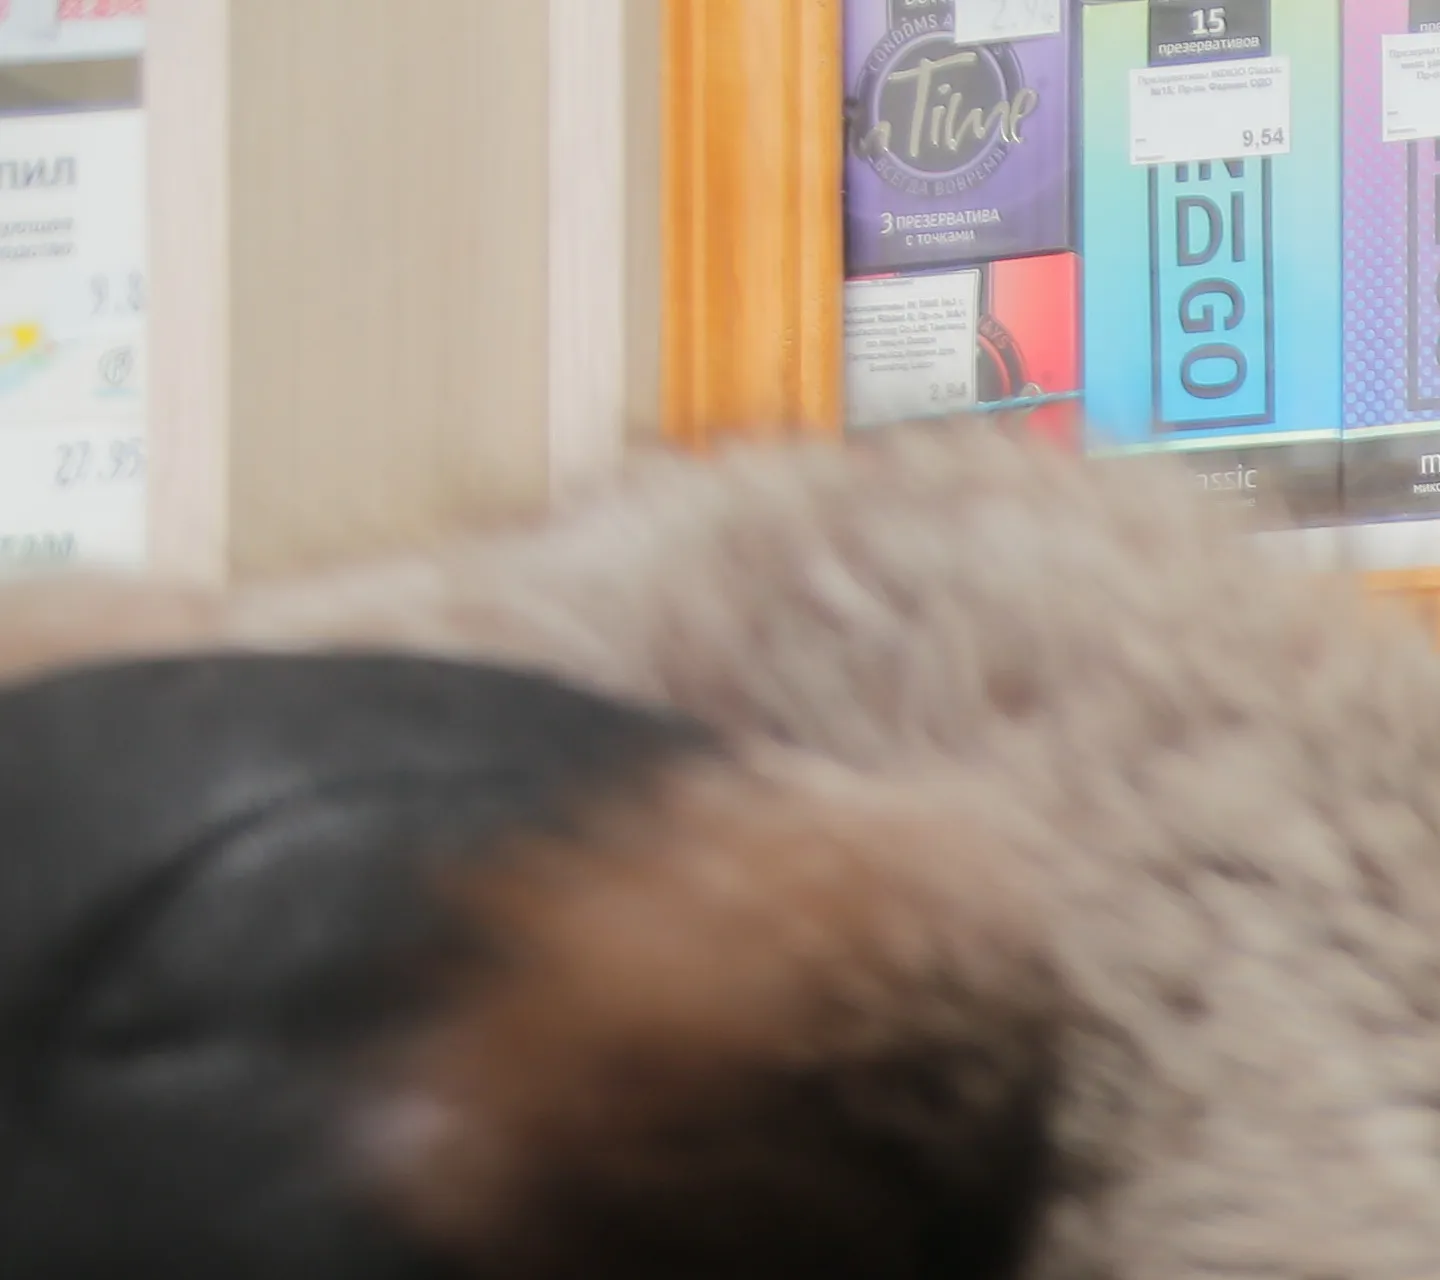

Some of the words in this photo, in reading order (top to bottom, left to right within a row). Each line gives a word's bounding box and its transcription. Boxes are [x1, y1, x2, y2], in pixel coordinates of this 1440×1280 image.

[1190, 8, 1227, 35] 15
[1157, 35, 1262, 56] презервативов
[1242, 127, 1285, 149] 9,54
[879, 212, 894, 234] 3
[896, 208, 1002, 231] ПРЕЗЕРВАТИВА
[917, 229, 976, 246] точками
